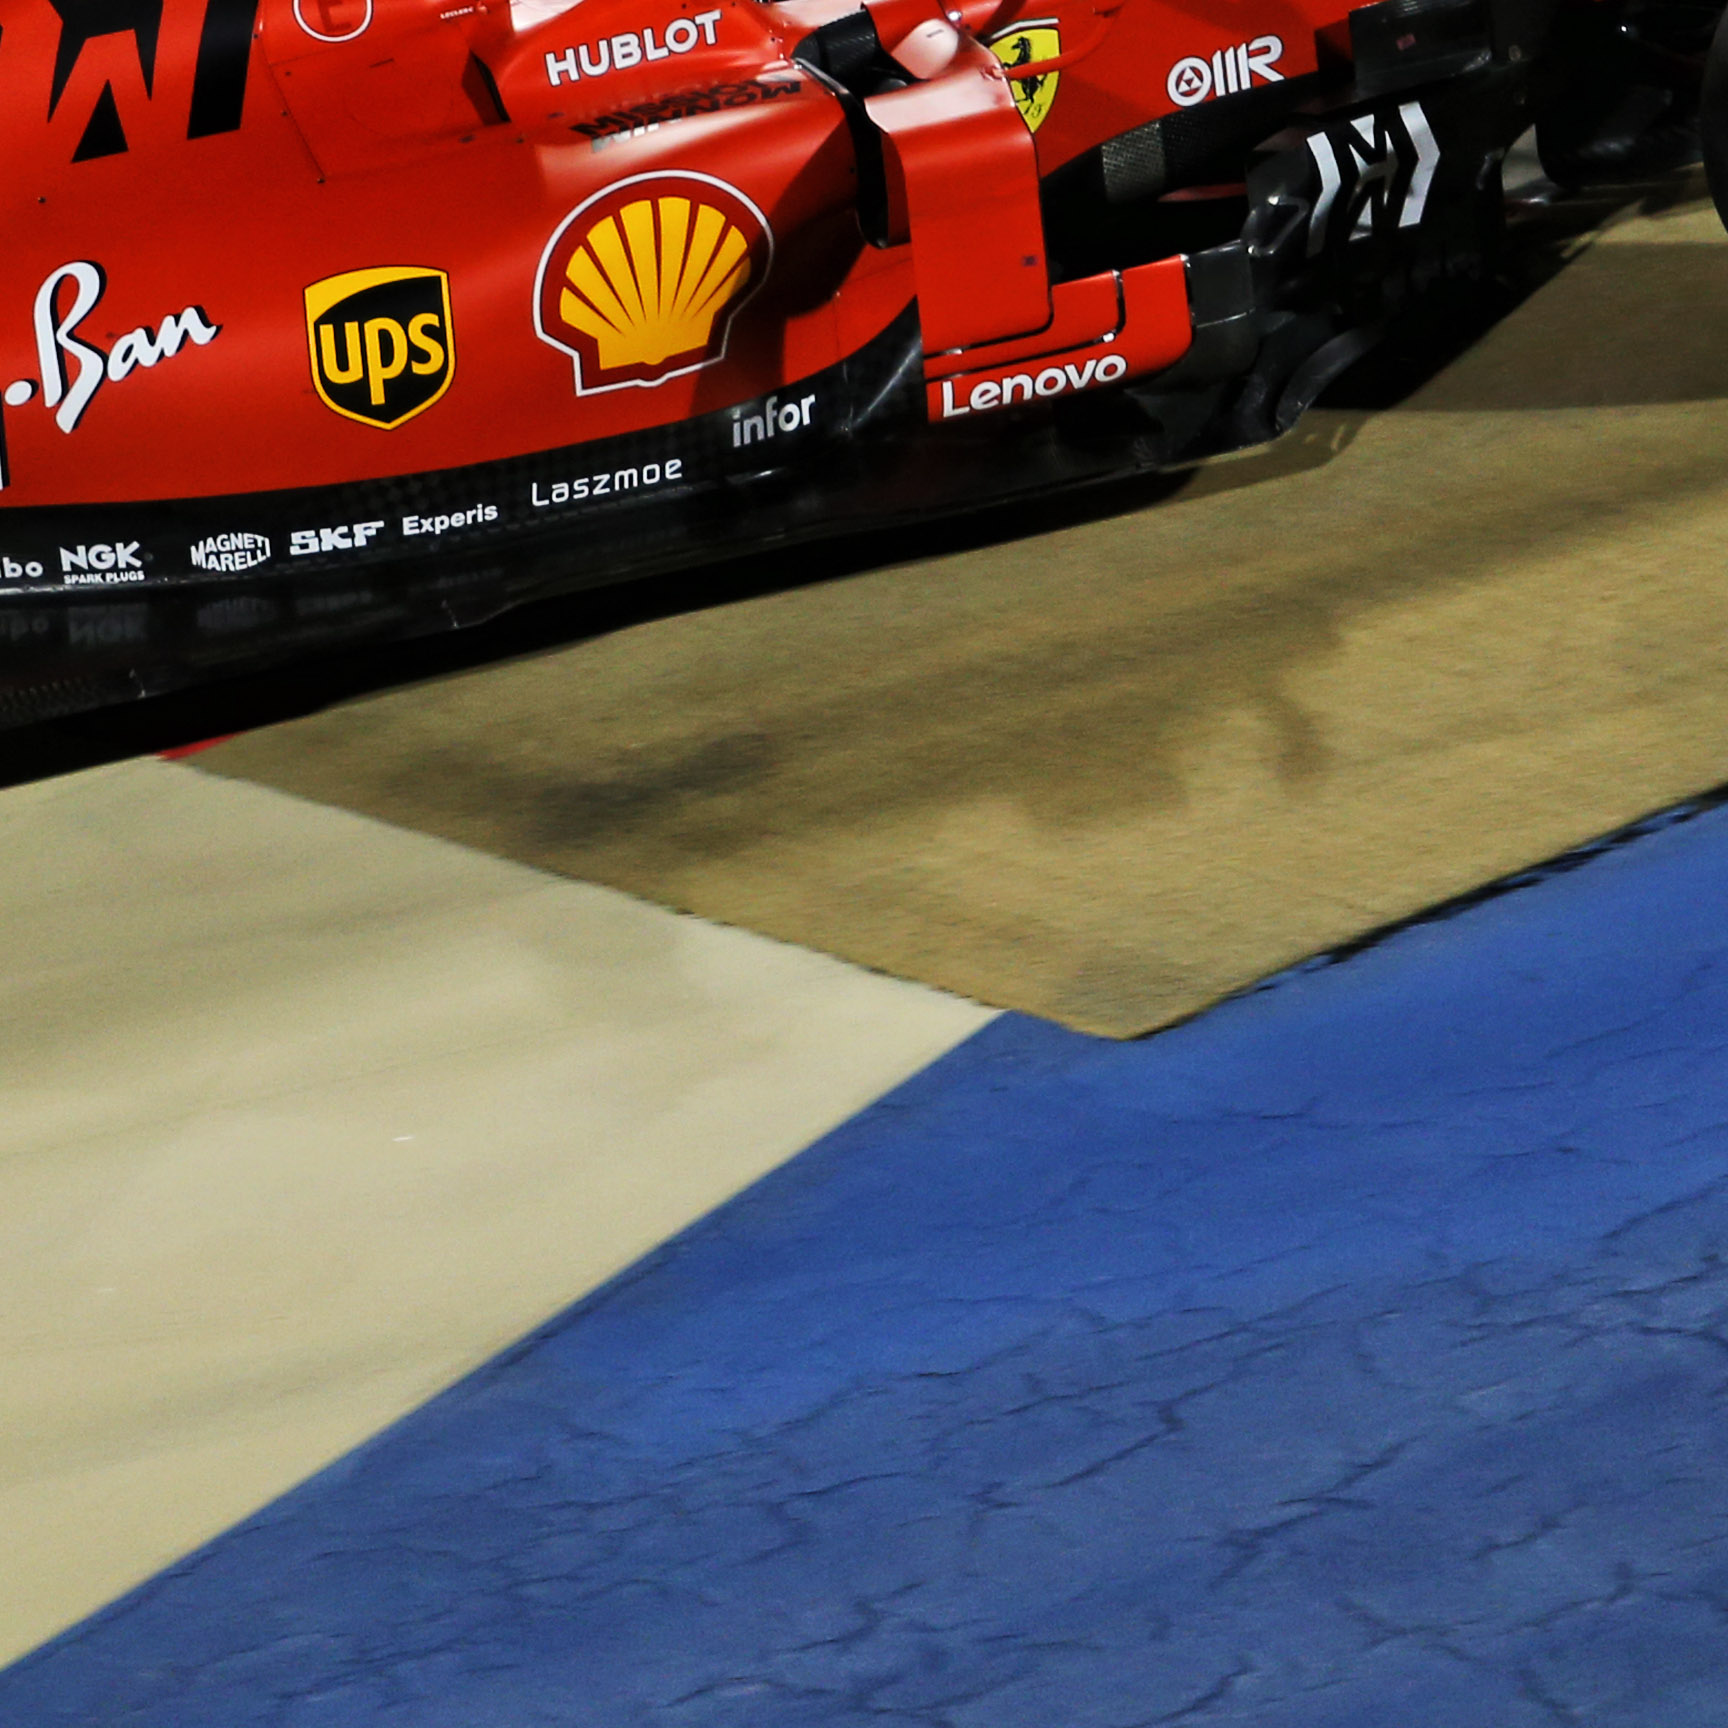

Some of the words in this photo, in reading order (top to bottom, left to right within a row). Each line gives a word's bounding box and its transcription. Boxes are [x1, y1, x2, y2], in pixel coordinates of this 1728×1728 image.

[545, 9, 722, 87] HUBLOT
[941, 354, 1128, 418] Lenovo
[732, 394, 817, 448] infor
[531, 457, 683, 507] Laszmoe
[290, 520, 384, 556] SKF
[402, 503, 498, 536] Experis
[59, 541, 143, 572] NGK
[63, 572, 103, 584] SPARK
[106, 570, 145, 583] PLUGS
